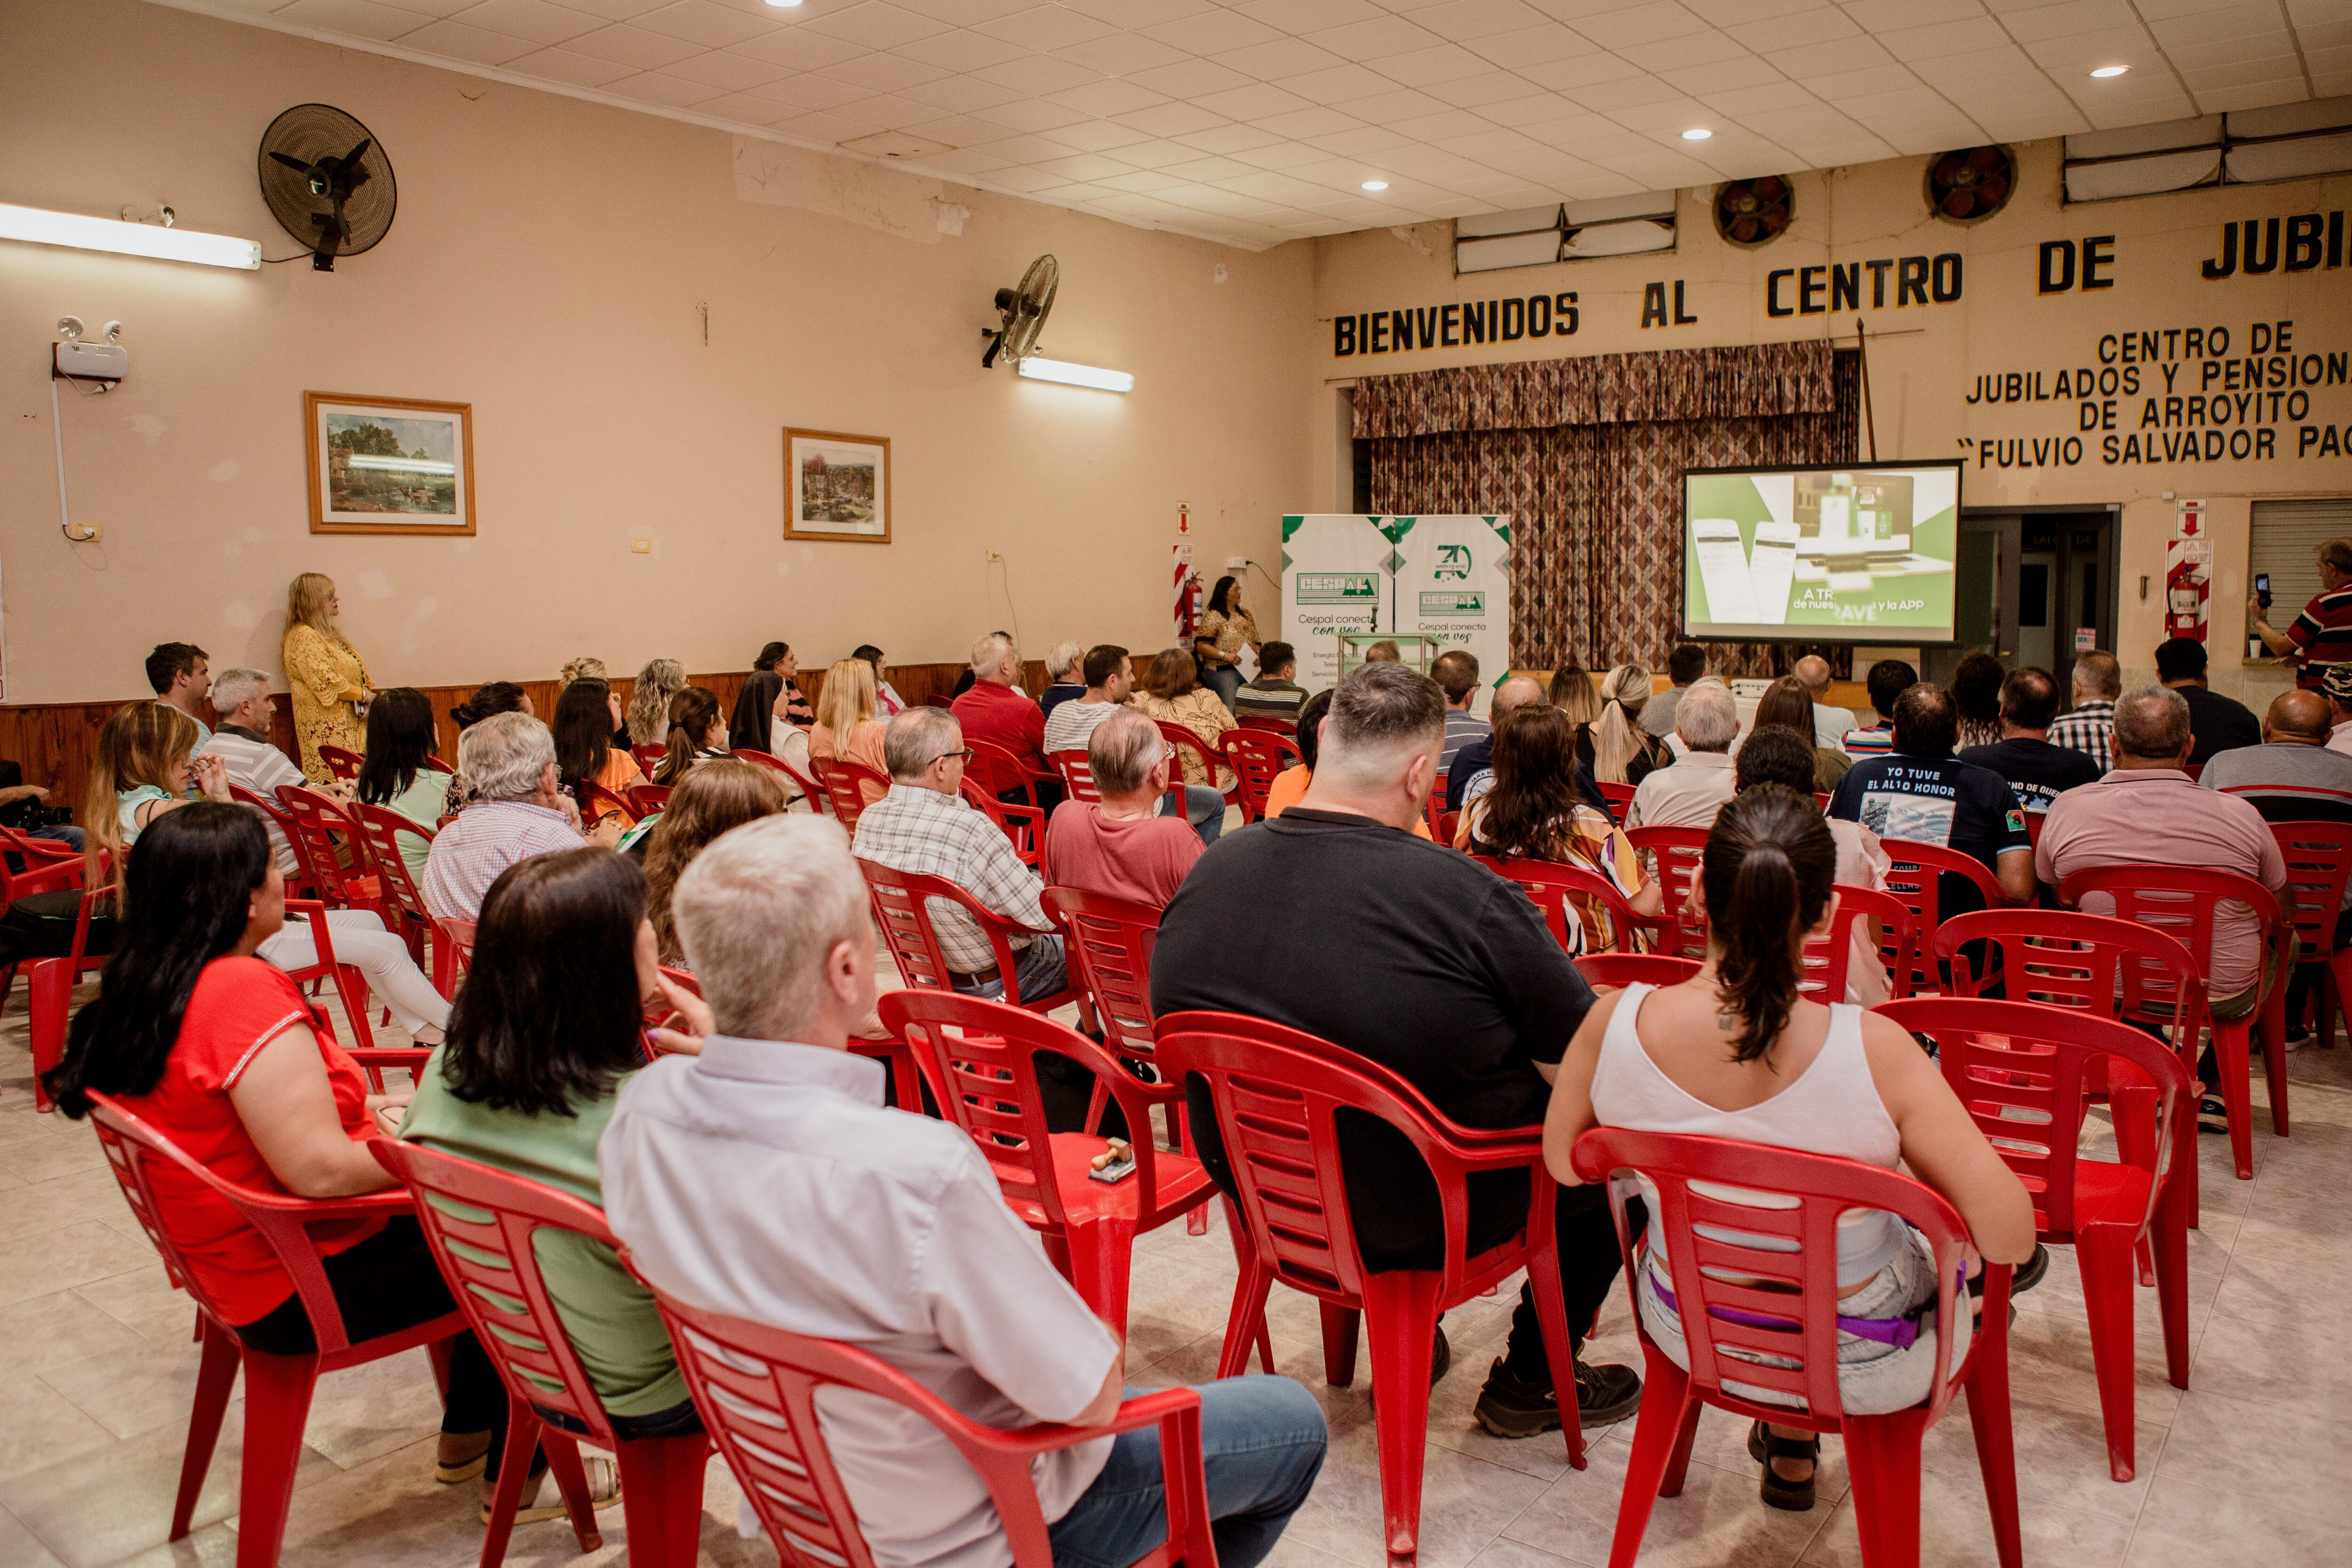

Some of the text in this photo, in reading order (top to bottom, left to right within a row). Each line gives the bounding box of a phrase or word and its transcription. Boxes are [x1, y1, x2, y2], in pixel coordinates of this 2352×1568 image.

[1334, 210, 2352, 357] BIENVENIDOS AL CENTRO DE JUBI
[2098, 320, 2293, 364] CENTRO DE
[1966, 351, 2352, 404] JUBILADOS Y PENSION
[2080, 390, 2309, 431] DE ARROYITO
[2102, 428, 2276, 466] SALVADOR
[1300, 577, 1368, 590] CESPAL
[1422, 595, 1476, 605] CESPAL
[1804, 589, 1815, 600] A
[1793, 599, 1924, 612] de nues y la APP
[1298, 614, 1371, 625] Cespal conect
[1312, 626, 1335, 635] con
[1418, 622, 1448, 632] Cespal
[1454, 632, 1472, 644] vos
[1887, 767, 1941, 781] YO TUVE
[1867, 780, 1878, 789] EL
[1914, 783, 1955, 797] HONOR
[2008, 781, 2024, 790] NO
[2026, 783, 2039, 792] DE
